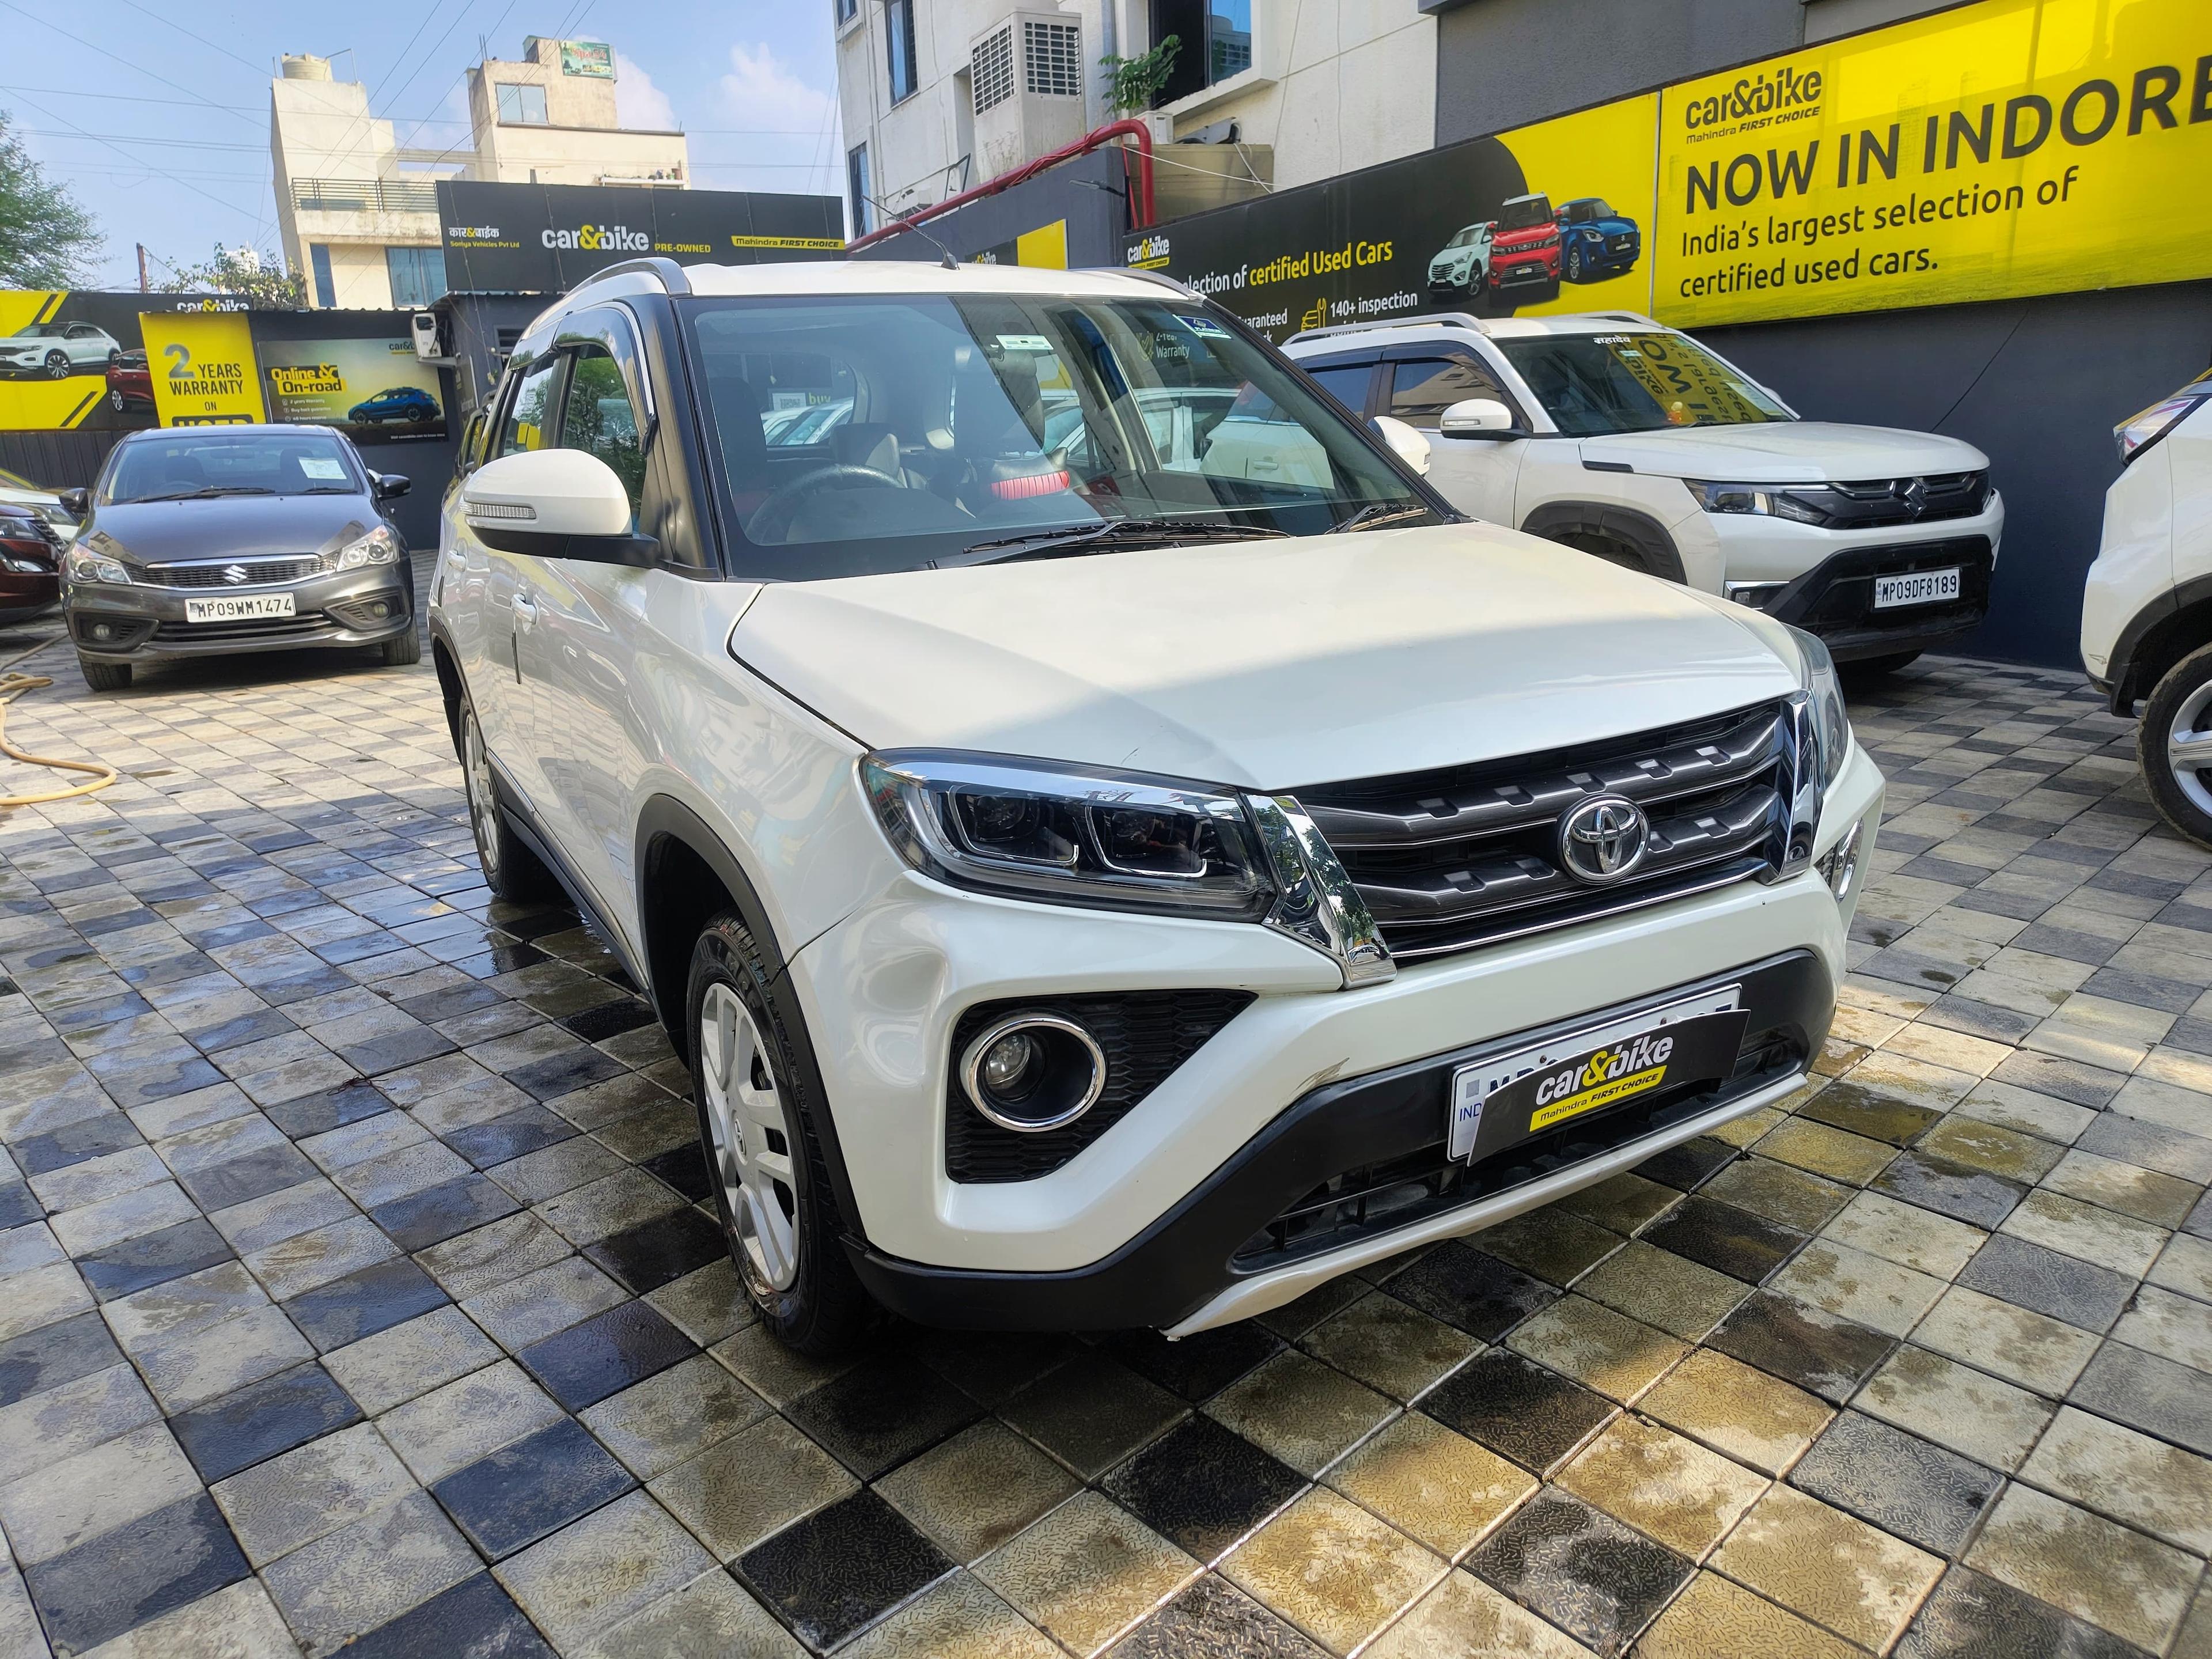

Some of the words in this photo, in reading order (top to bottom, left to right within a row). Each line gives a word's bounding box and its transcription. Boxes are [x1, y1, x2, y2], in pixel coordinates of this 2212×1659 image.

[1685, 67, 1821, 128] car&bike
[1687, 127, 1736, 144] Mahindra
[1739, 117, 1773, 133] FIRST
[1775, 106, 1820, 125] CHOICE
[1686, 140, 1820, 214] NOW
[1838, 123, 1900, 188] IN
[1682, 220, 1759, 257] India's
[1767, 205, 1865, 245] largest
[1873, 183, 2023, 230] selection
[2036, 165, 2080, 206] of
[541, 225, 649, 251] car&bike
[654, 243, 711, 253] PRE-OWNED
[1128, 236, 1169, 262] car&bike
[1233, 264, 1248, 287] of
[1249, 252, 1309, 286] certified
[1313, 243, 1351, 274] Used
[1355, 241, 1392, 266] Cars
[1680, 257, 1786, 298] certified
[1794, 248, 1859, 285] used
[1869, 248, 1938, 277] cars.
[1330, 300, 1355, 317] 140+
[1358, 291, 1418, 315] inspection
[164, 343, 195, 378] 2
[198, 363, 242, 378] YEARS
[1156, 344, 1190, 358] Warranty
[169, 380, 243, 395] WARRANTY
[271, 367, 316, 381] Online
[282, 380, 342, 393] On-road
[204, 402, 217, 411] ON
[1882, 575, 1957, 602] MP09DF8189
[198, 598, 292, 618] MP09WM1474
[1536, 1036, 1673, 1105] car&bike
[1540, 1098, 1587, 1121] Mahindra
[1590, 1086, 1622, 1103] FIRST
[1622, 1073, 1659, 1093] CHOICE
